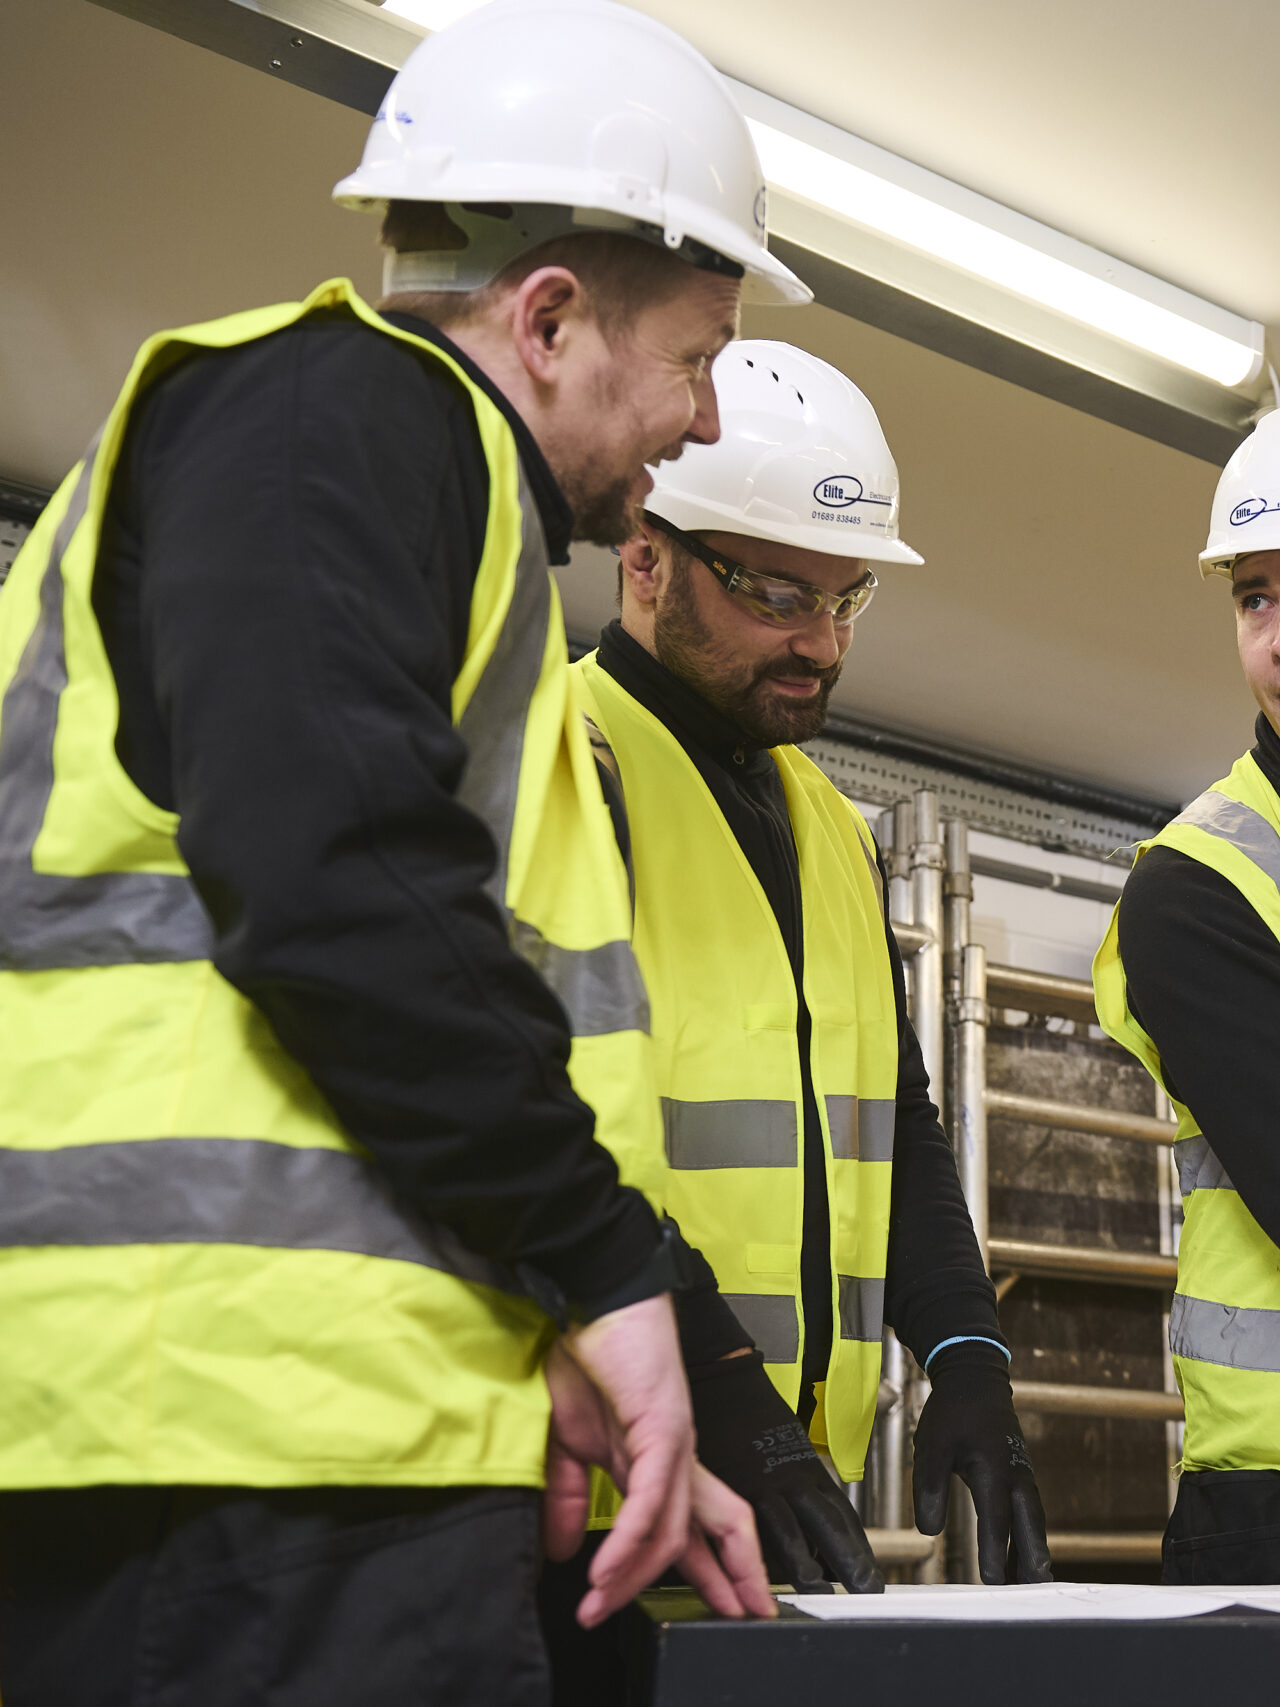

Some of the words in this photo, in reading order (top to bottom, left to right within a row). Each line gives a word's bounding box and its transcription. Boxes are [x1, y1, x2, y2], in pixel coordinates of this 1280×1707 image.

[823, 484, 844, 499] Elite
[811, 511, 835, 521] 01689
[1236, 508, 1251, 519] Elite
